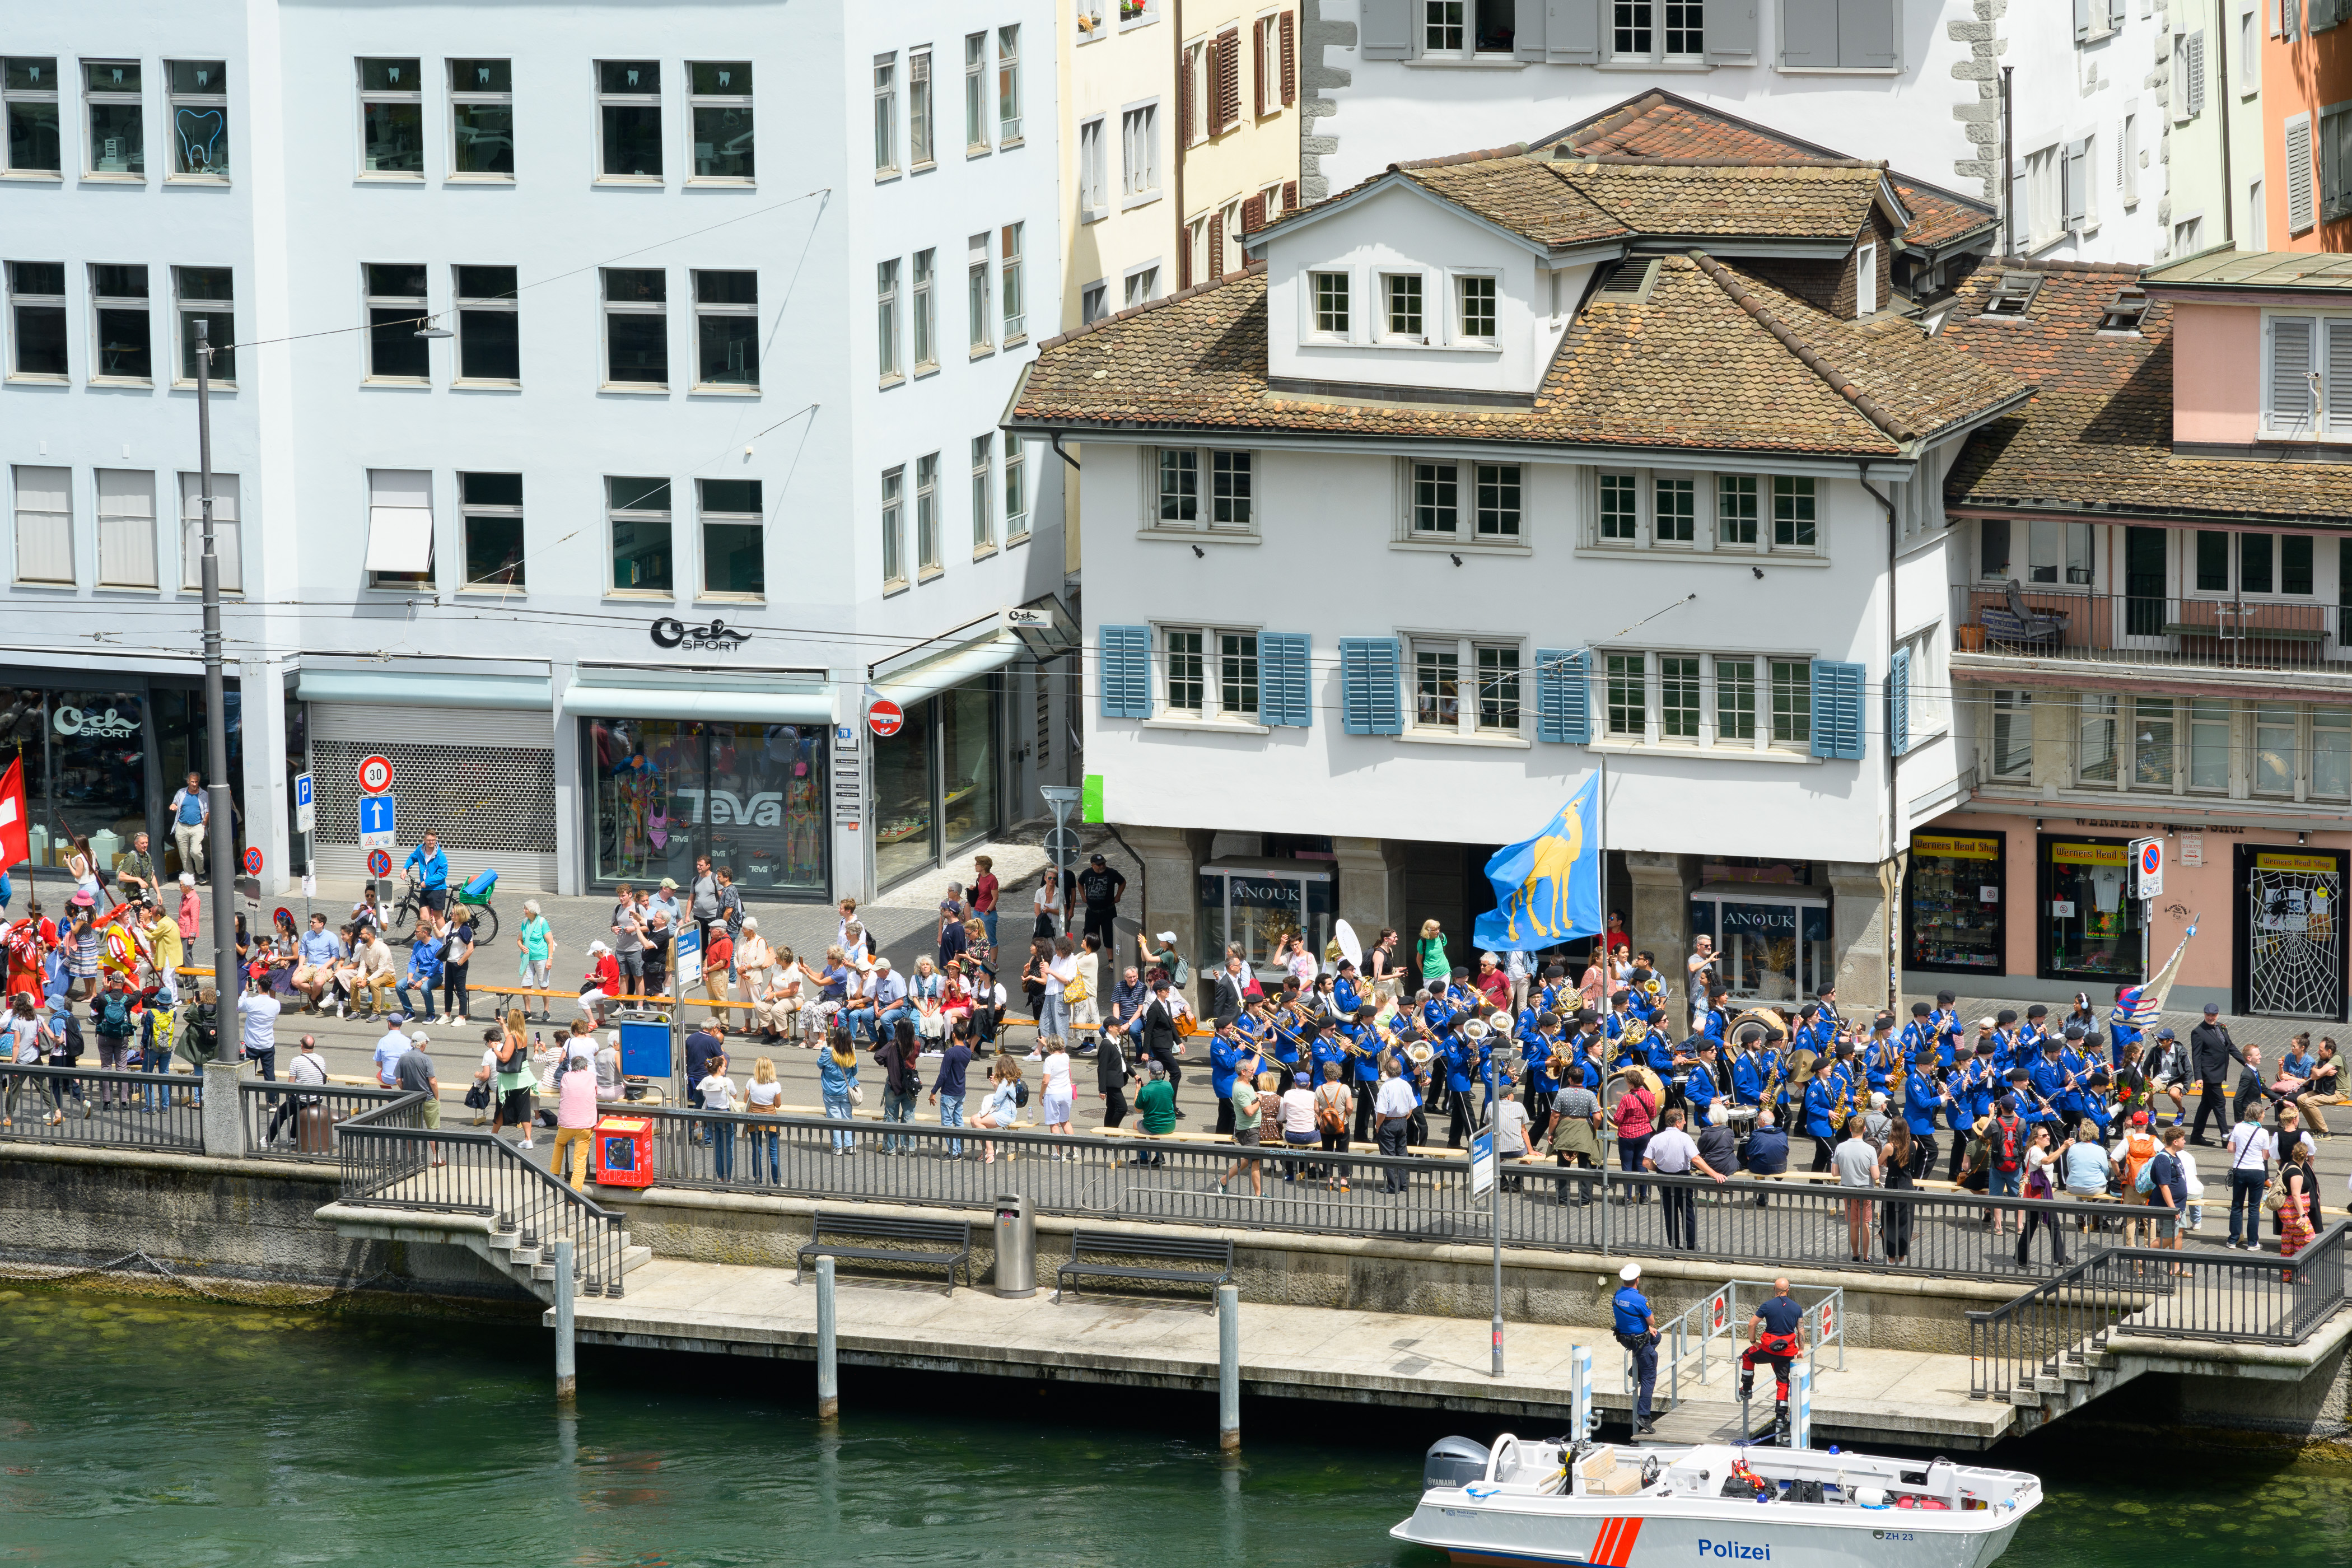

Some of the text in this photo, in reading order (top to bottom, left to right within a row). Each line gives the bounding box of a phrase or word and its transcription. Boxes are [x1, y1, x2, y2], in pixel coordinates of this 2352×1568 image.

[1009, 610, 1039, 620] Och
[651, 617, 753, 648] Och
[682, 640, 741, 651] SPORT
[53, 706, 141, 735] Och
[80, 727, 132, 738] SPORT
[370, 768, 381, 781] 30
[301, 781, 309, 802] P
[1914, 839, 1999, 855] Werners Head Shop
[2056, 847, 2093, 858] Werners
[2096, 849, 2117, 860] Head
[2264, 857, 2330, 870] Werners Head Shop
[1232, 886, 1300, 901] ANOUK
[1723, 912, 1795, 927] ANOUK
[678, 939, 688, 948] Zürich
[1432, 1478, 1457, 1487] YAMAHA
[1698, 1539, 1770, 1560] Polizei
